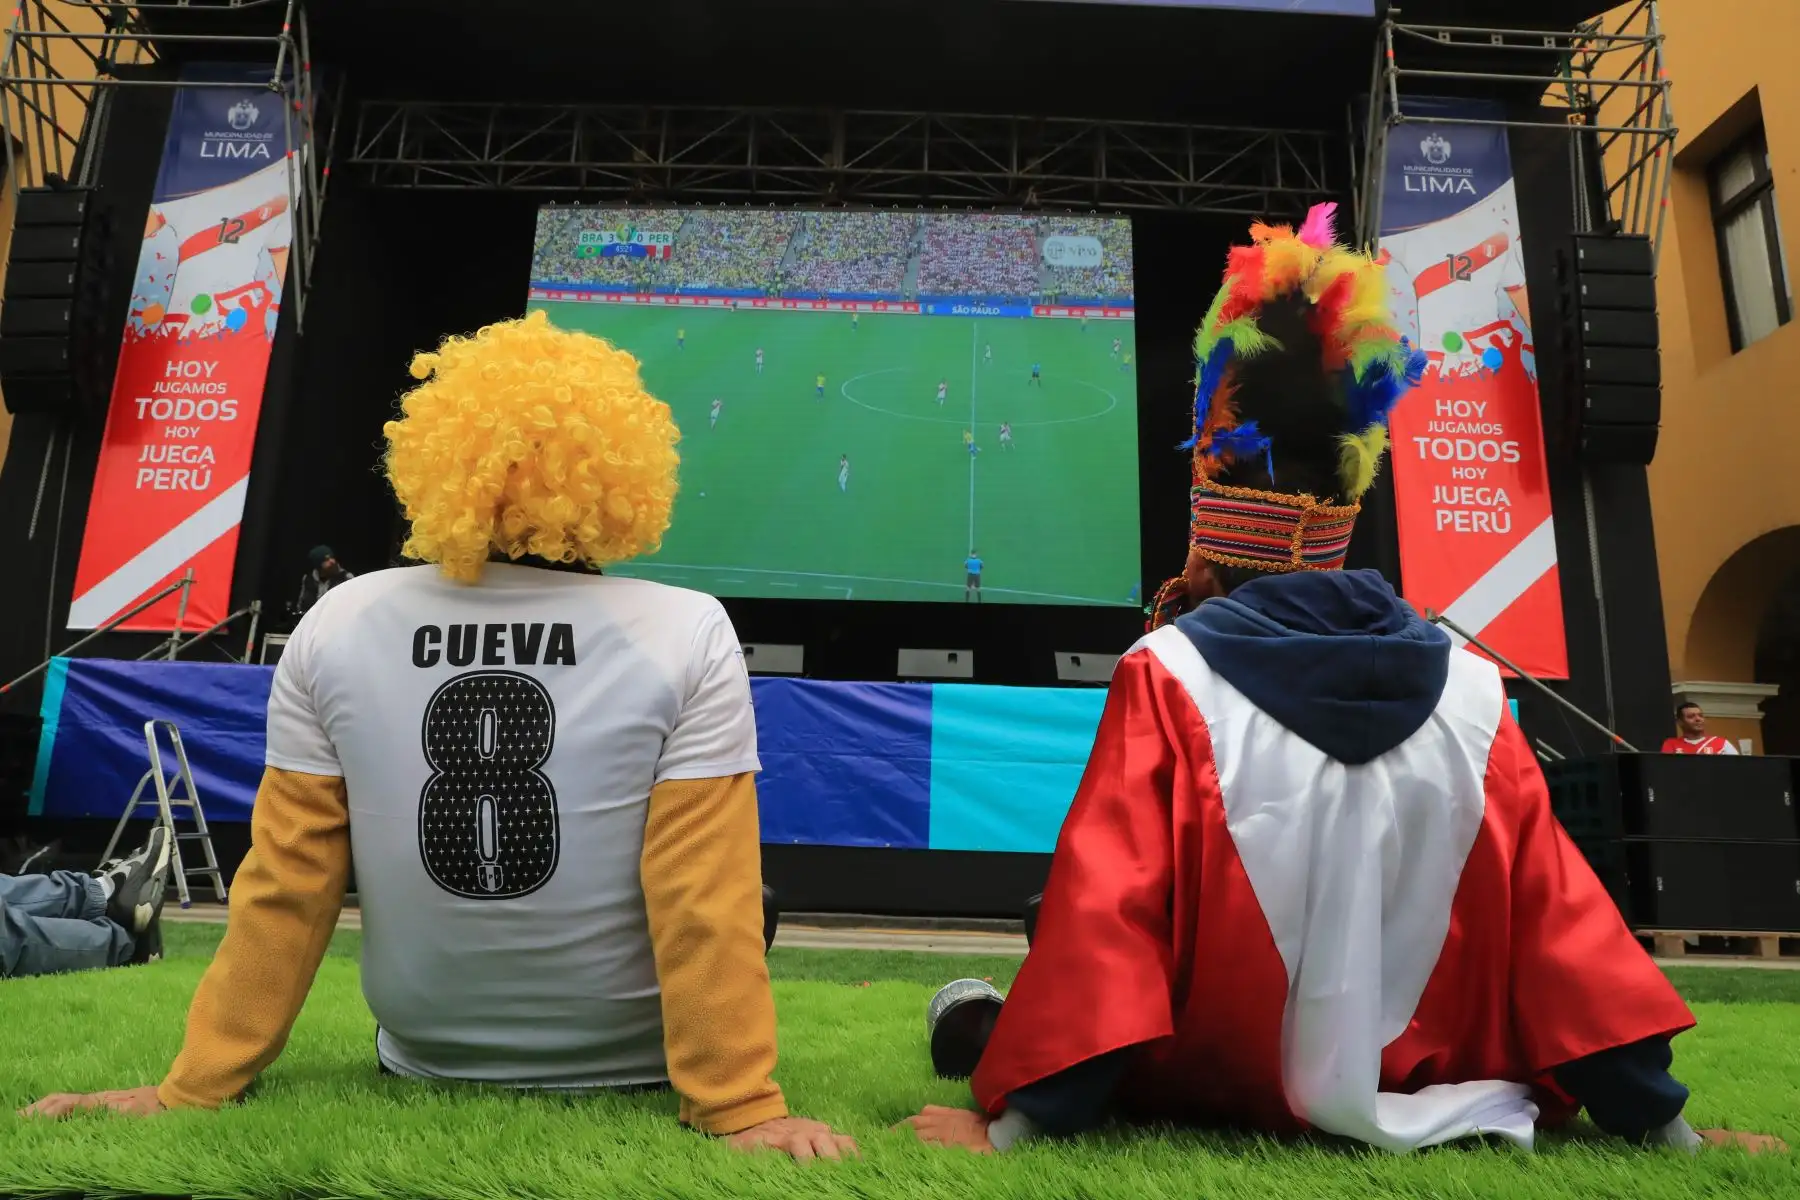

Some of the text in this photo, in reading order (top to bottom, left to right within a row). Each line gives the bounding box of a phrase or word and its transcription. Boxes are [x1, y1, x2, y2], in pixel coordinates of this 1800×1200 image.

[200, 142, 270, 159] LIMA
[1403, 165, 1461, 173] MUNICIPALIDAD
[1404, 175, 1477, 195] LIMA
[218, 217, 245, 244] 12
[582, 233, 670, 243] BRA 3 0 PER
[1446, 253, 1472, 282] 12
[952, 305, 1000, 316] SÃO PAULO
[165, 360, 219, 378] HOY
[152, 381, 227, 394] JUGAMOS
[135, 398, 238, 421] TODOS
[1435, 399, 1487, 418] HOY
[164, 426, 200, 439] HOY
[1427, 420, 1503, 435] JUGAMOS
[137, 445, 215, 464] JUEGA
[1412, 436, 1520, 463] TODOS
[135, 464, 212, 491] PERÚ
[1452, 466, 1487, 480] HOY
[1431, 485, 1512, 507] JUEGA
[1436, 506, 1512, 533] PERÚ
[412, 623, 577, 668] CUEVA
[418, 669, 561, 900] 8
